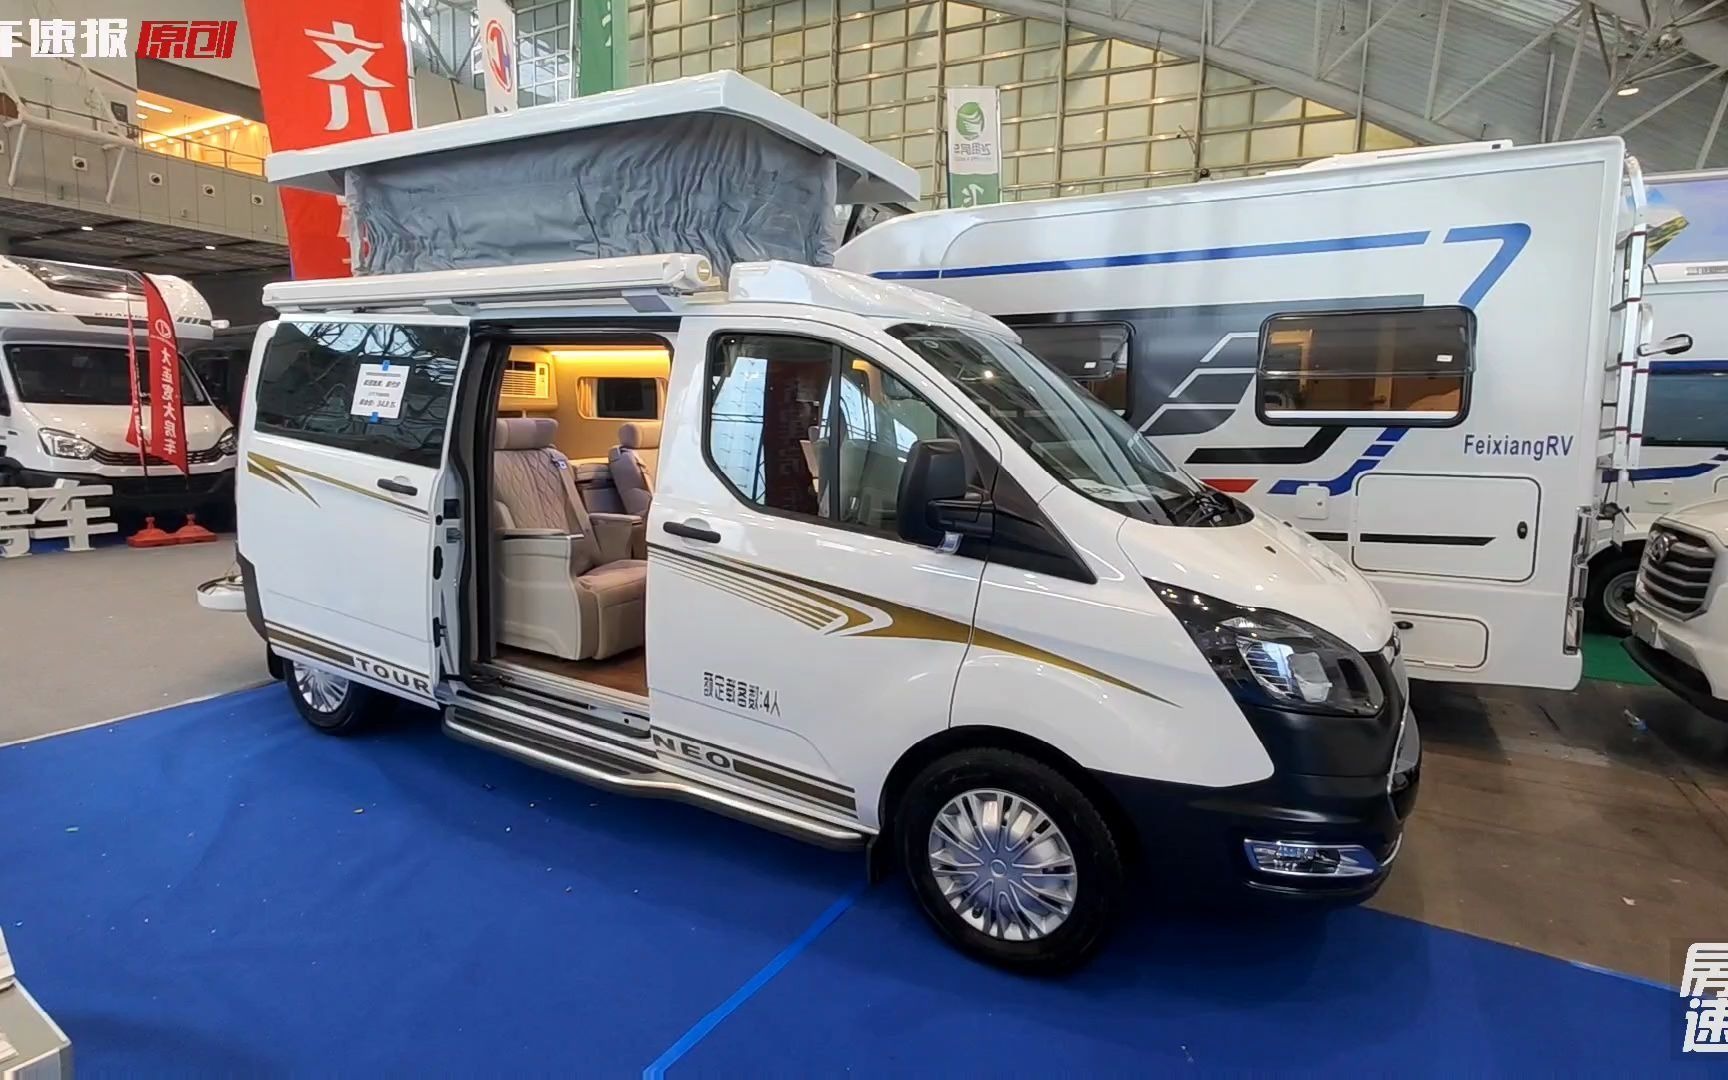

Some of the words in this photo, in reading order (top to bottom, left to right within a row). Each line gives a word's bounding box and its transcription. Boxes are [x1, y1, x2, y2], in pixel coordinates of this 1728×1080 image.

[1463, 434, 1574, 461] FeixiangRV
[357, 658, 431, 693] TOUR
[653, 734, 732, 770] NEO
